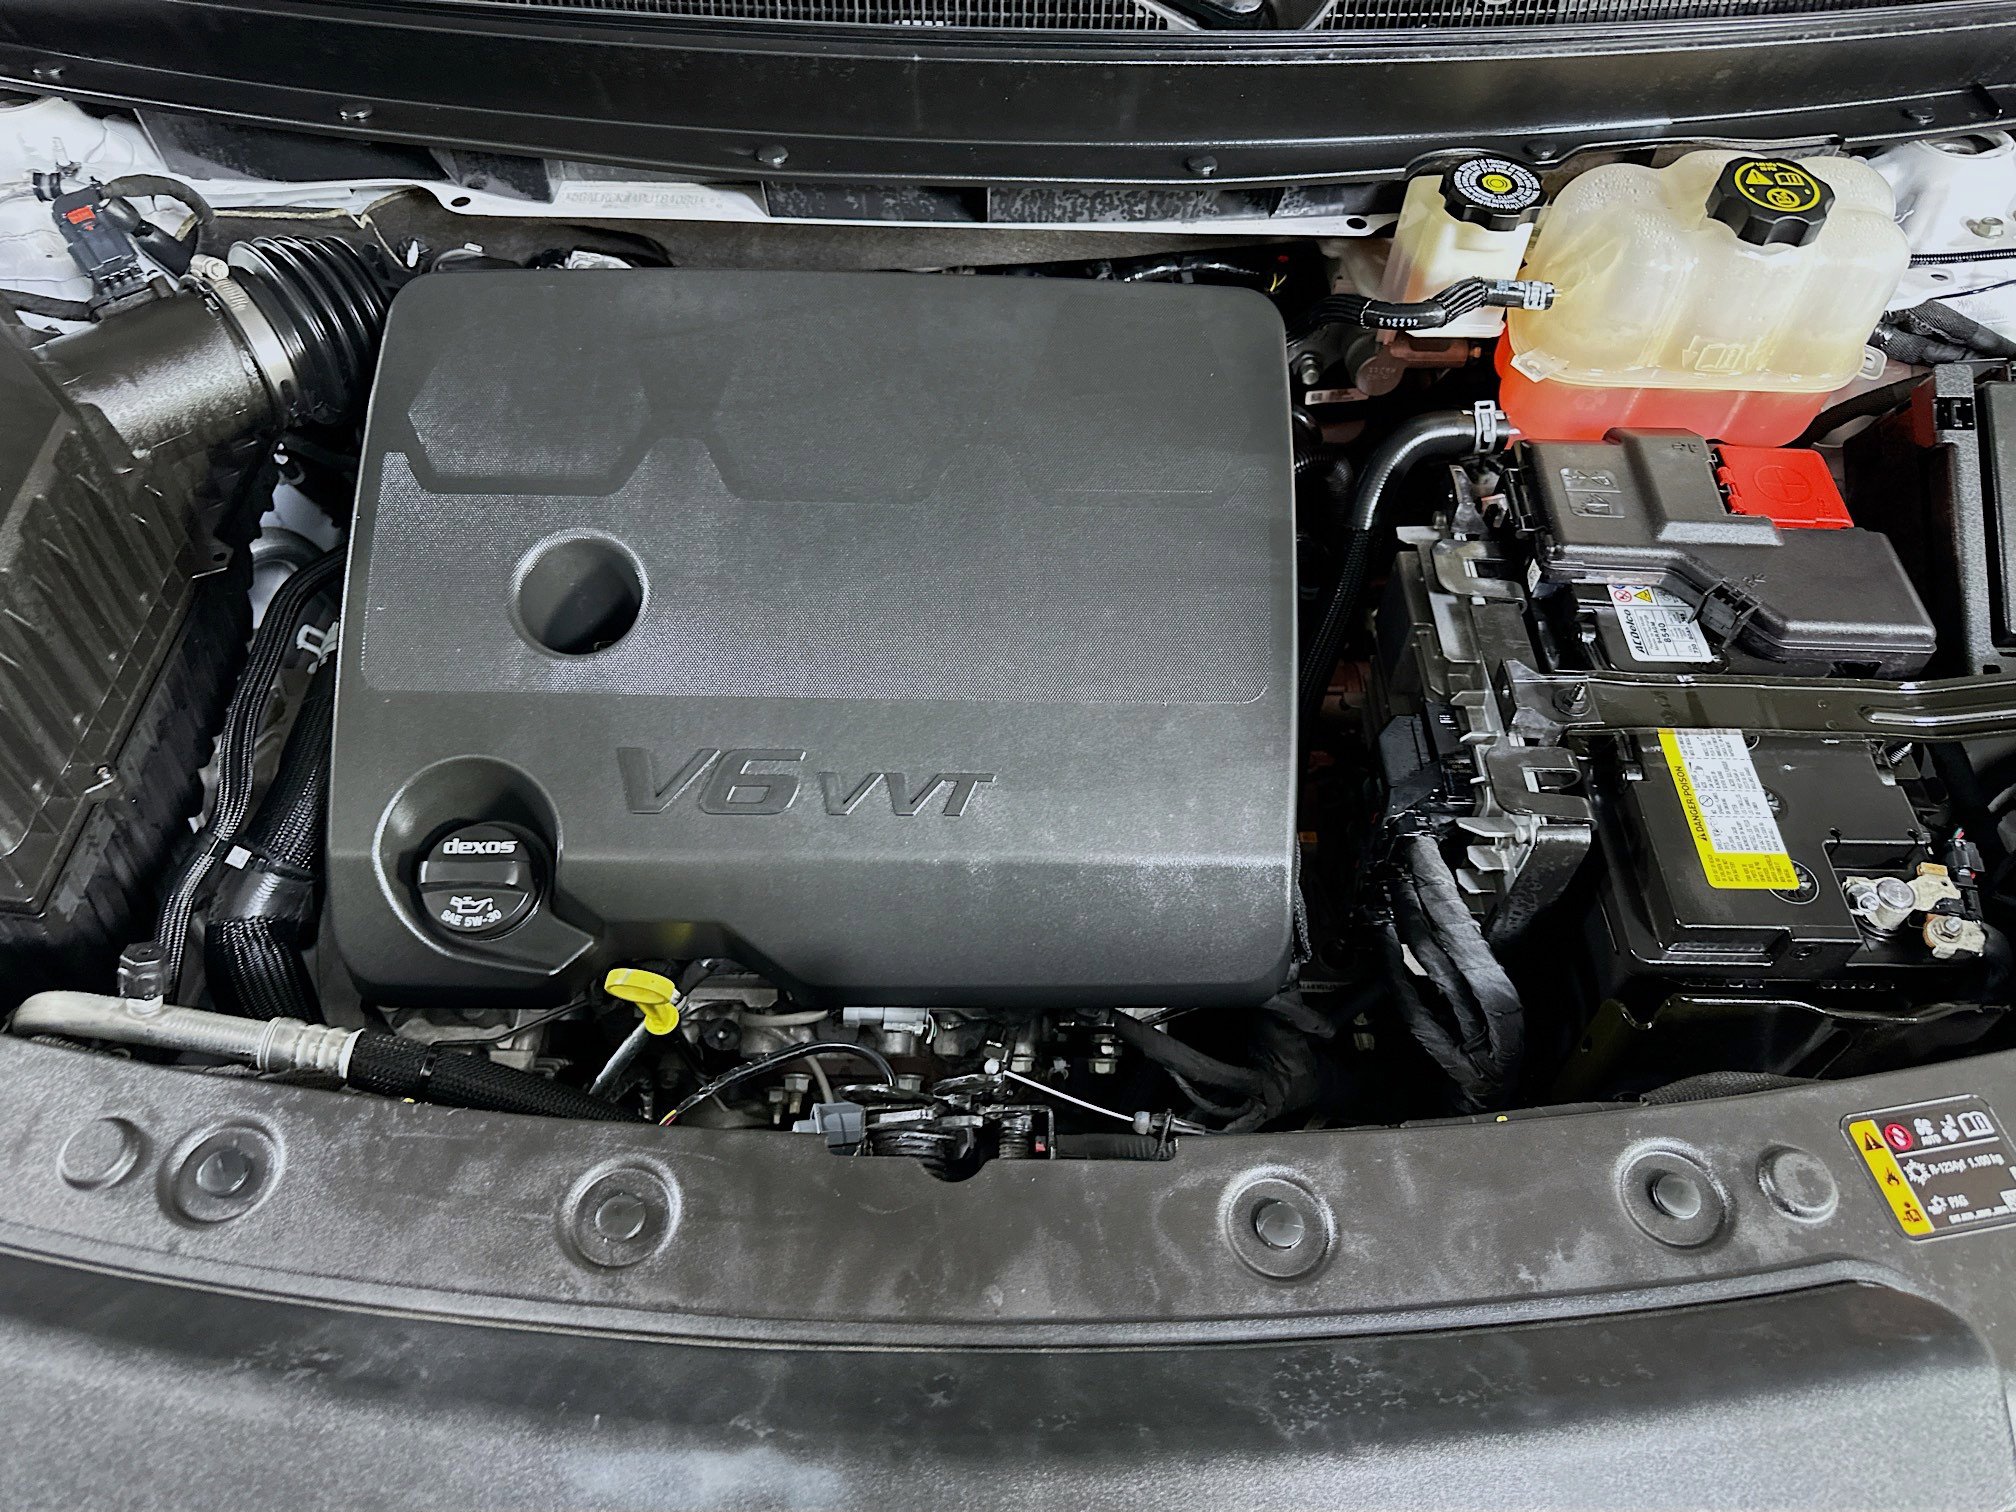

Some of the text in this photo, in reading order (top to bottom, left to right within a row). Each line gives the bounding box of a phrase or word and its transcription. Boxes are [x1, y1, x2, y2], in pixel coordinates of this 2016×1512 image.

[1624, 609, 1645, 653] ACDelco
[1658, 622, 1672, 642] 8540
[617, 746, 996, 816] V6 VVT
[443, 838, 518, 854] dexos
[441, 909, 502, 927] SAE 5W-30
[1947, 1194, 1969, 1209] PAG
